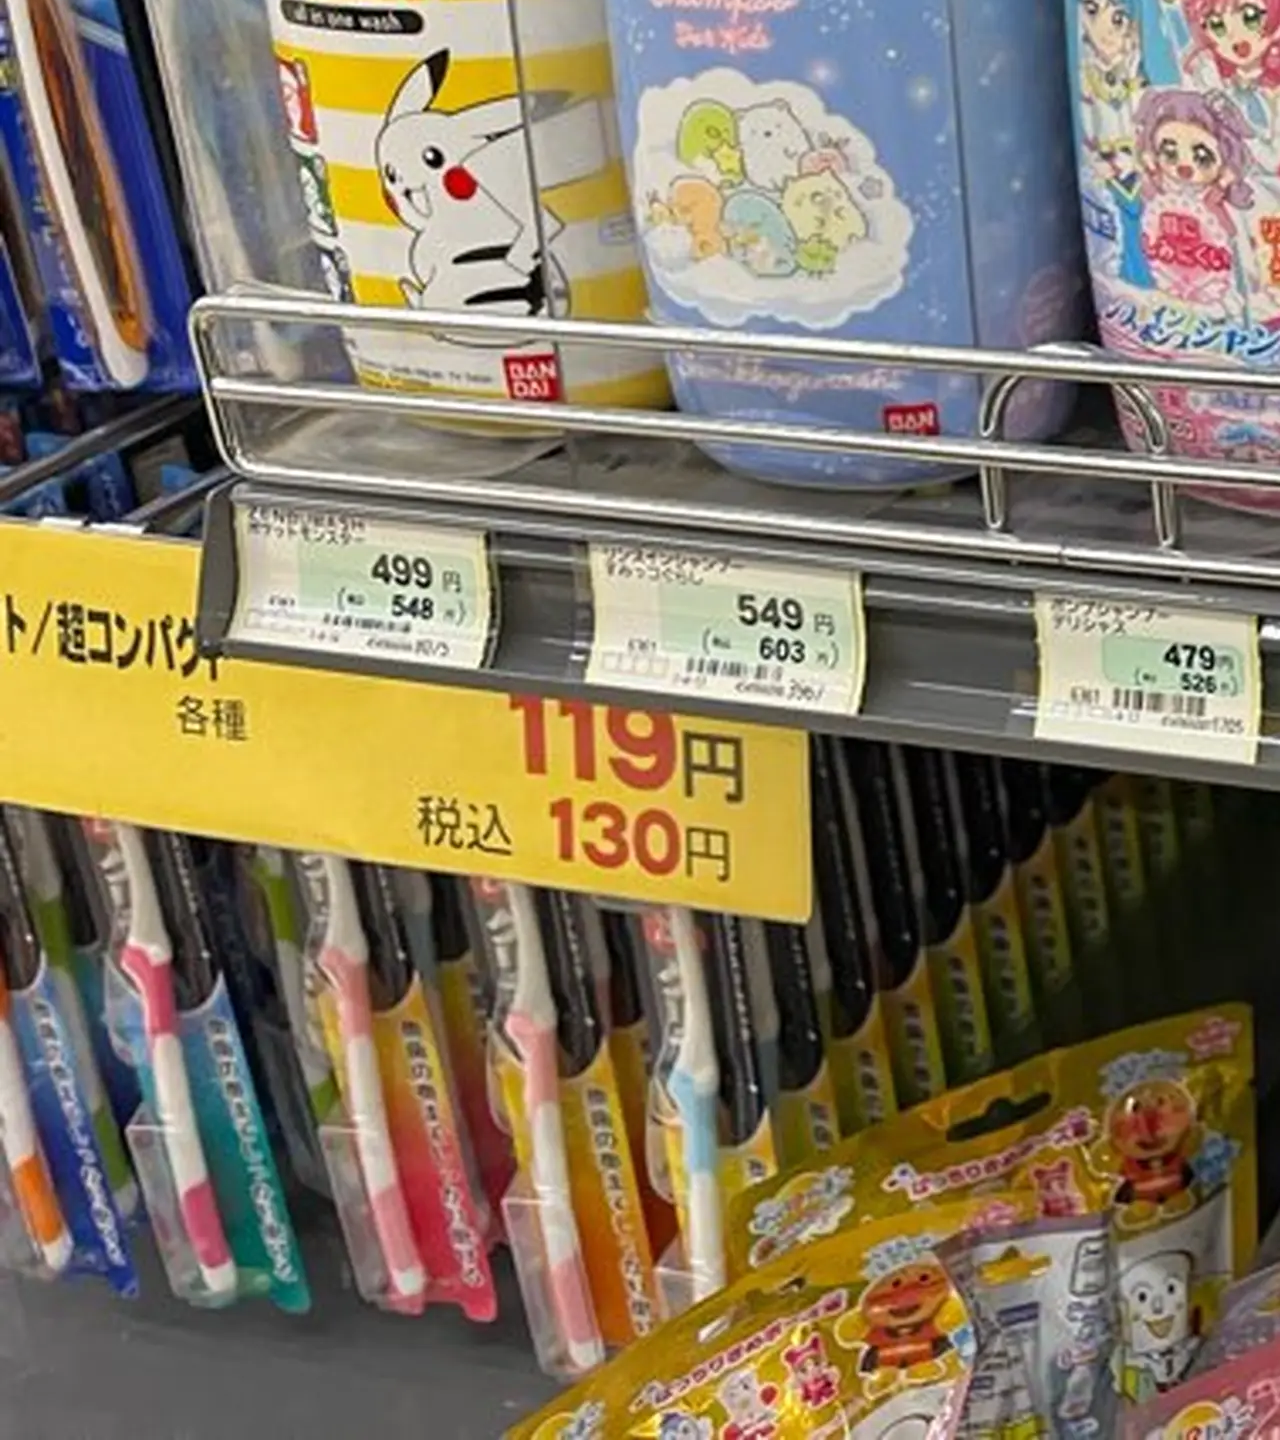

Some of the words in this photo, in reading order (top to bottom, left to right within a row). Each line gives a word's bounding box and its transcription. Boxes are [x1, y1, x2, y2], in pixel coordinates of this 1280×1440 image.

[509, 361, 557, 380] BAN
[512, 380, 550, 398] DAI
[888, 411, 935, 430] BAN
[391, 595, 433, 619] 548
[6, 593, 224, 681] ト/超コンパク
[759, 636, 805, 663] 603
[176, 696, 249, 741] 各種
[418, 797, 513, 857] 税込
